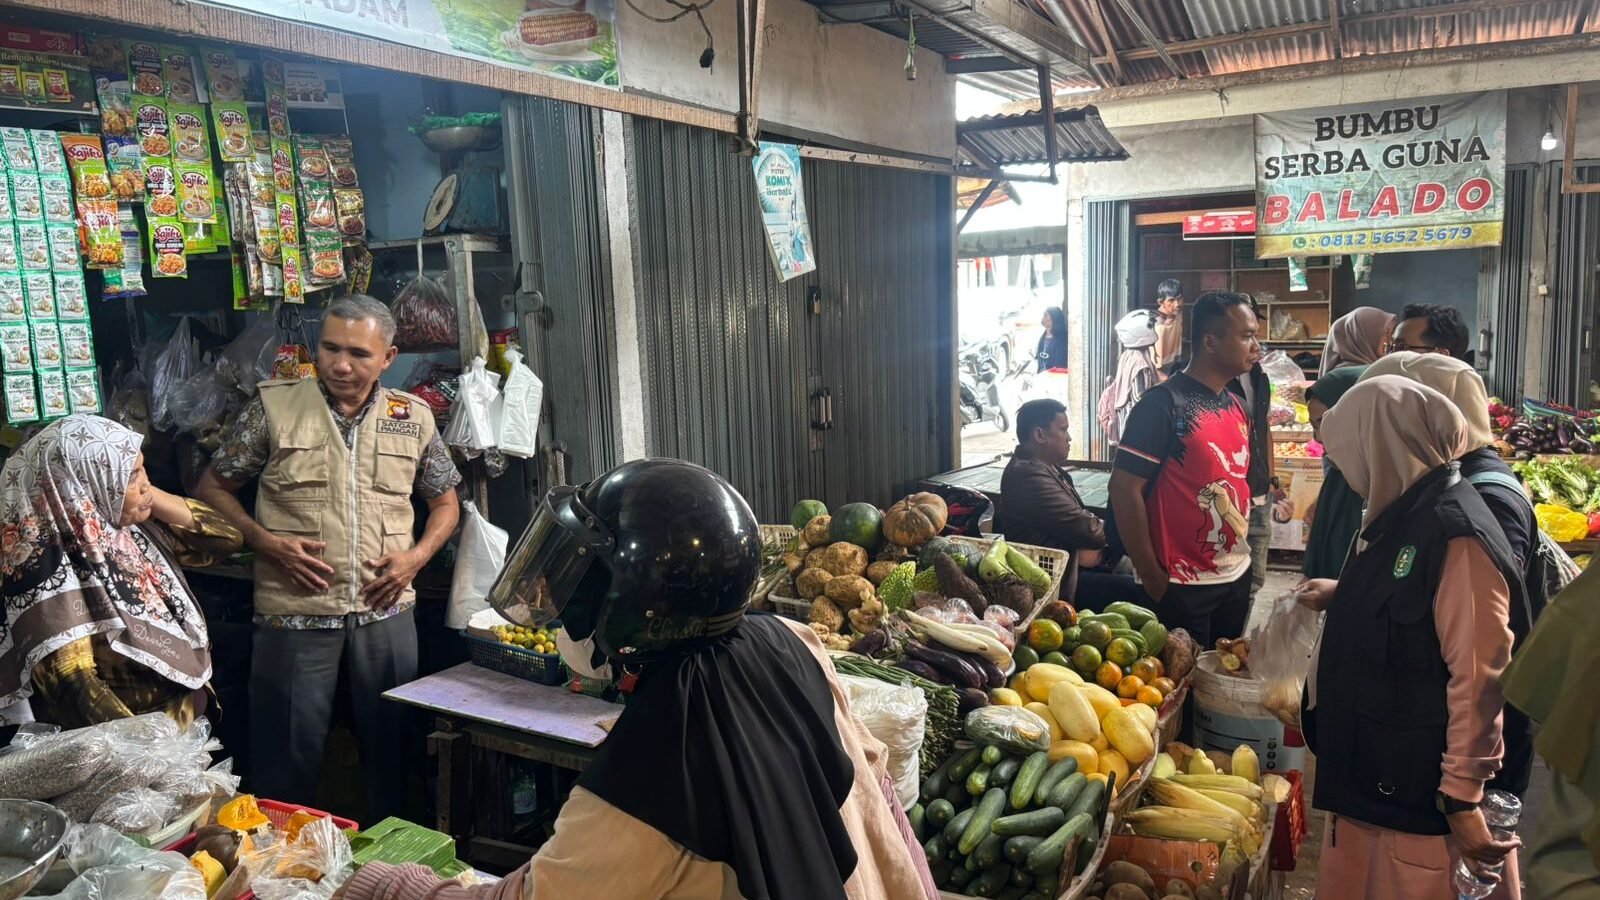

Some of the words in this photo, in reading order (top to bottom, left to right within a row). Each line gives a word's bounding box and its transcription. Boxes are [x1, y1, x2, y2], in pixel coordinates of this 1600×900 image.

[304, 0, 409, 29] DAM
[175, 113, 203, 130] Sajiku
[219, 109, 246, 126] Sajiku
[1314, 105, 1442, 142] BUMBU
[67, 145, 104, 162] Sajiku
[1264, 148, 1370, 180] SERBA
[1382, 136, 1491, 170] GUNA
[182, 172, 209, 188] Sajiku
[1263, 177, 1494, 226] BALADO
[155, 226, 183, 243] Sajiku
[1319, 232, 1367, 248] 0812
[1371, 229, 1421, 245] 5652
[1423, 226, 1473, 241] 5679
[380, 426, 417, 436] PANGAN
[382, 420, 417, 430] SATGAS
